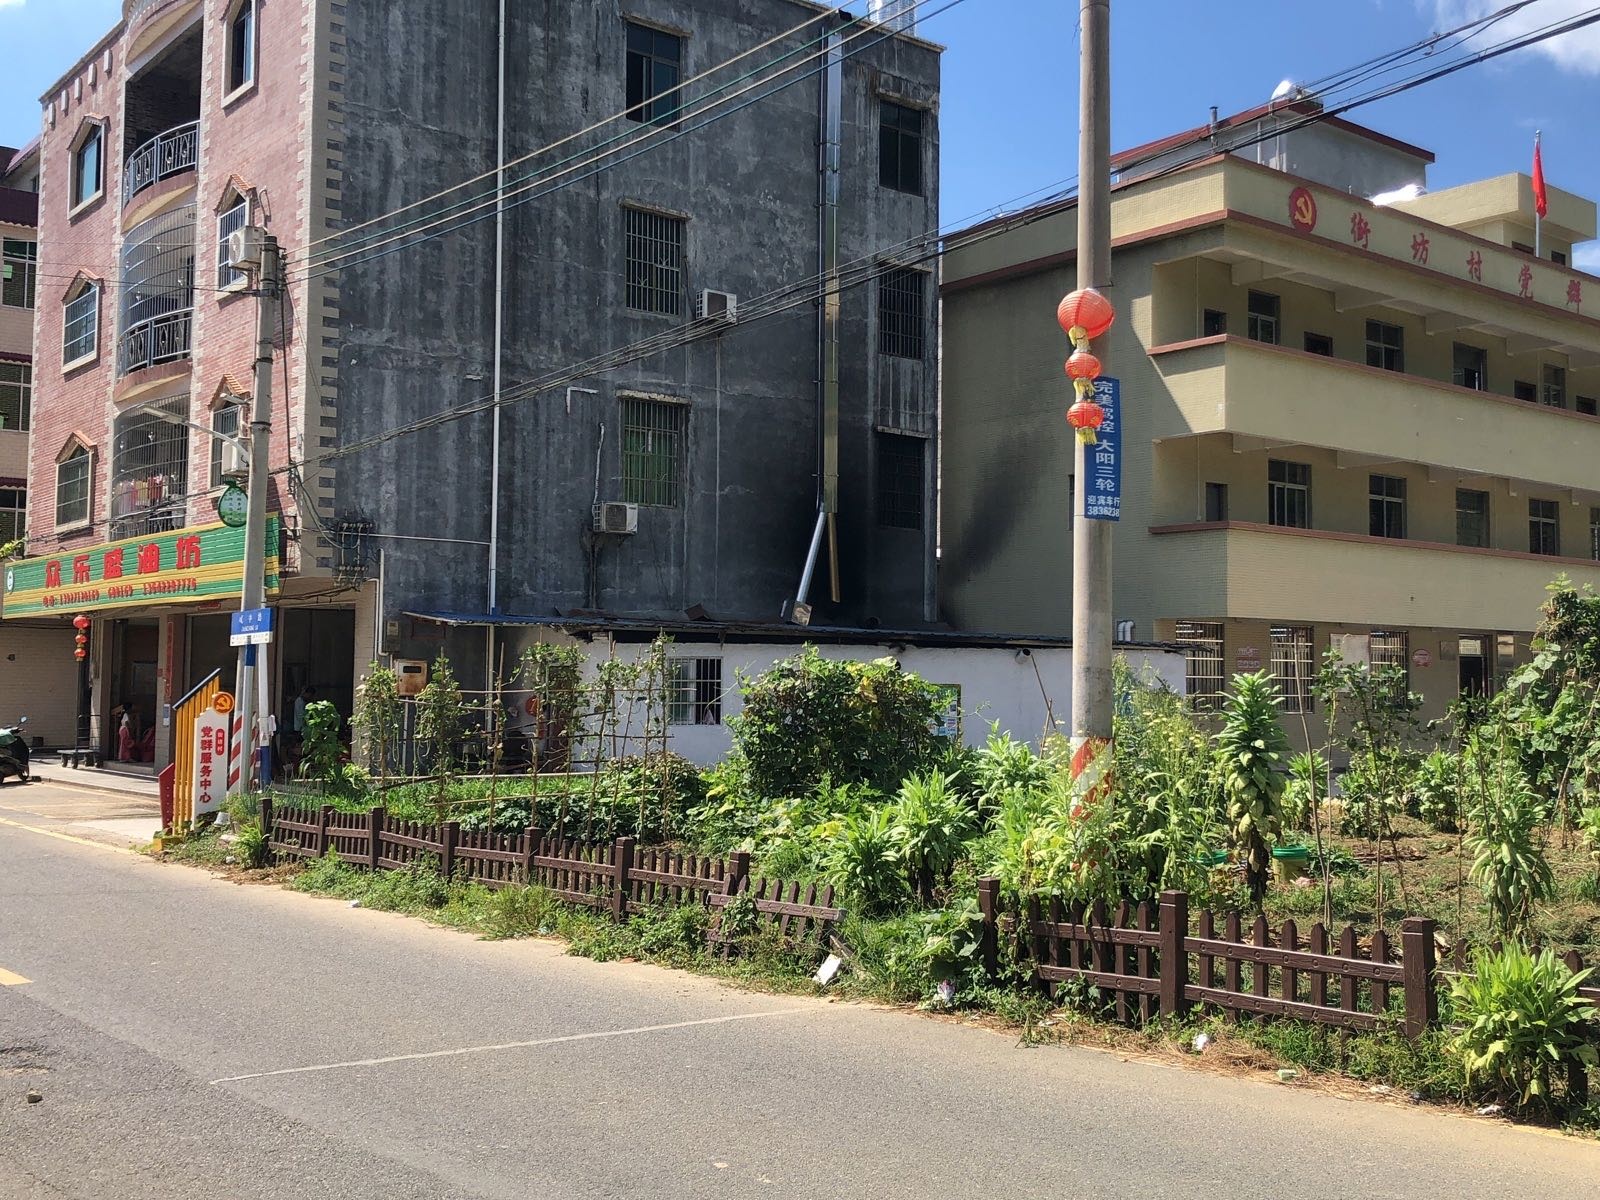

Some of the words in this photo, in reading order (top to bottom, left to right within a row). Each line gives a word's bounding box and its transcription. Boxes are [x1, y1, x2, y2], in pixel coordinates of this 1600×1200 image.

[1095, 439, 1115, 492] 大阳三轮
[1087, 506, 1120, 517] 3836238
[45, 535, 201, 589] 众乐盛油坊
[200, 726, 213, 803] 党群服务中心
